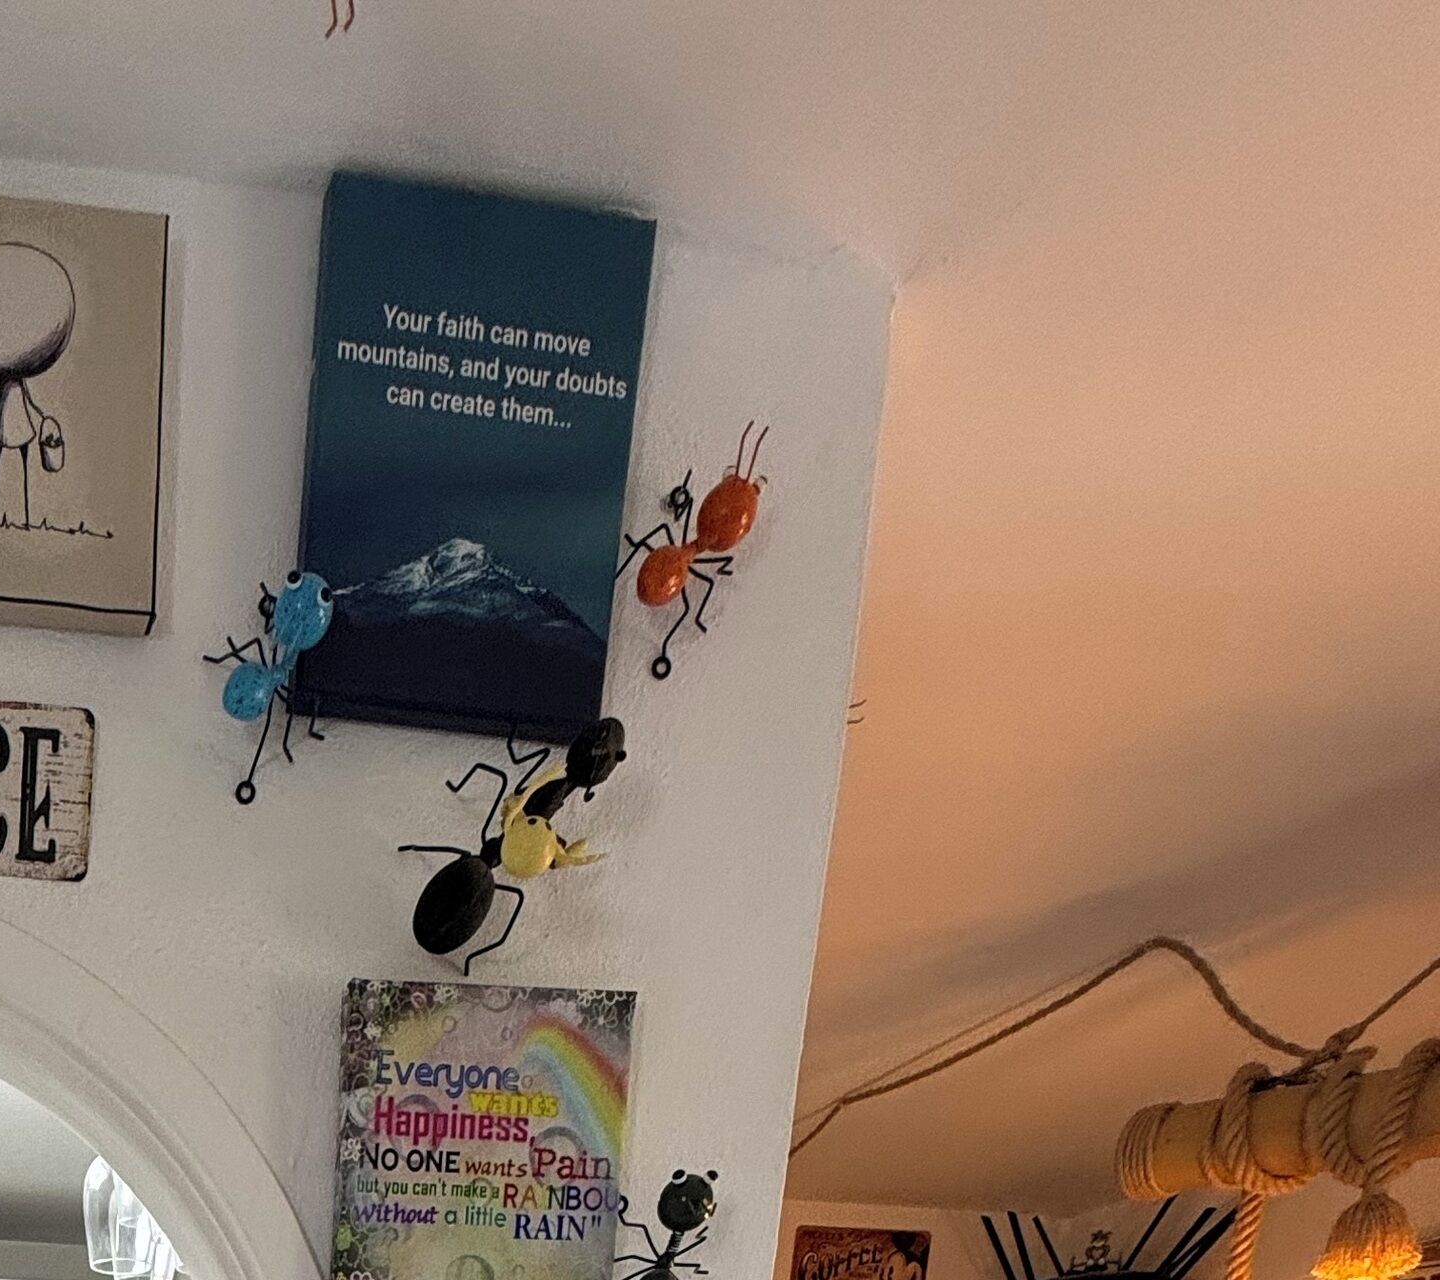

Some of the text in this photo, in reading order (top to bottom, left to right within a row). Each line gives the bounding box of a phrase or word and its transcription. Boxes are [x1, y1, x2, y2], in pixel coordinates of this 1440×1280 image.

[383, 303, 591, 358] Your faith can move
[337, 340, 627, 399] mountains, and your doubts
[387, 384, 571, 429] can create them...
[373, 1096, 535, 1146] Happiness,
[468, 1091, 558, 1117] wants
[360, 1143, 613, 1180] NO ONE wants Pain
[357, 1179, 378, 1193] but
[384, 1181, 408, 1197] you
[412, 1178, 447, 1197] can't
[451, 1182, 487, 1199] make
[491, 1187, 500, 1199] a
[356, 1203, 601, 1241] Without a little RAIN"
